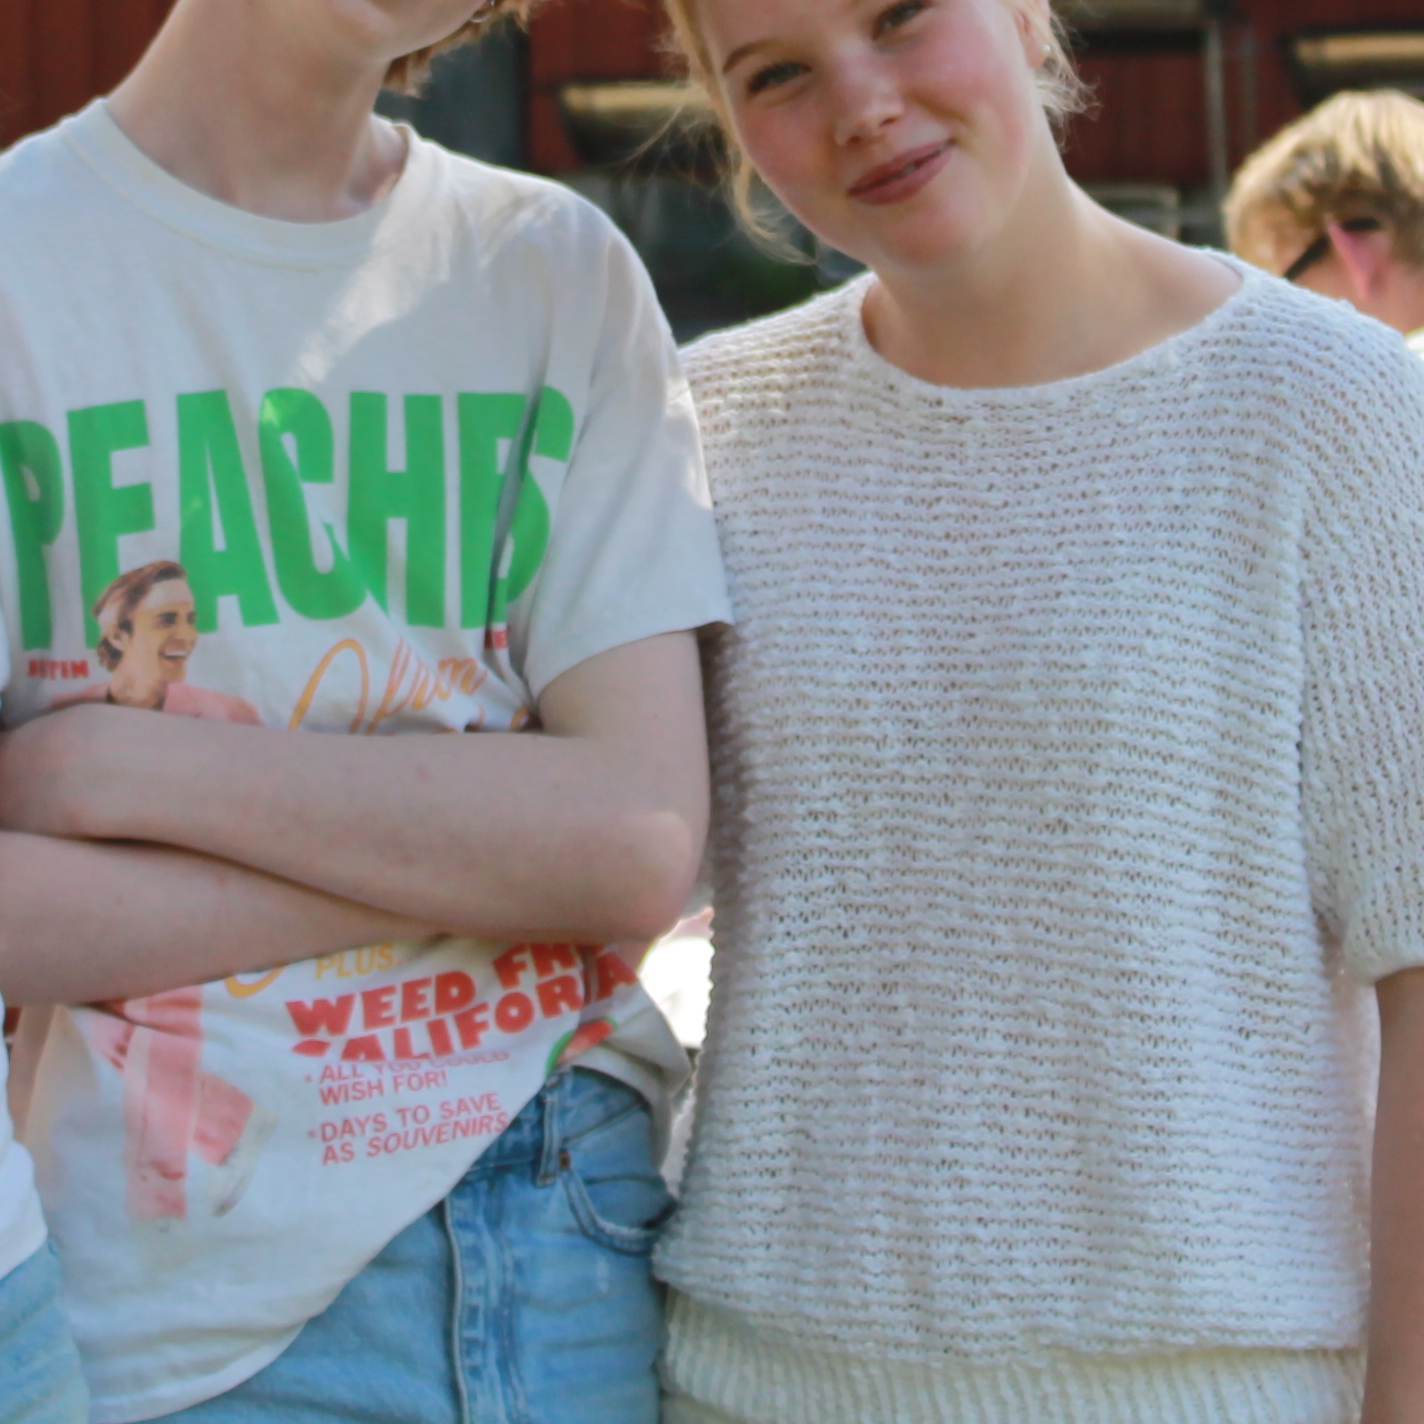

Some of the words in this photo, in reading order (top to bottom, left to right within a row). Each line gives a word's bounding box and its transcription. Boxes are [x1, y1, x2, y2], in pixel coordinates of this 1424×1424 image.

[284, 969, 476, 1038] WEED
[318, 1077, 384, 1107] WISH
[392, 1069, 448, 1095] FOR!
[319, 1062, 364, 1085] ALL
[319, 1111, 388, 1143] DAYS
[396, 1104, 431, 1128] TO
[439, 1091, 502, 1121] SAVE
[321, 1141, 355, 1166] AS
[366, 1111, 509, 1158] SOUVENIRS
